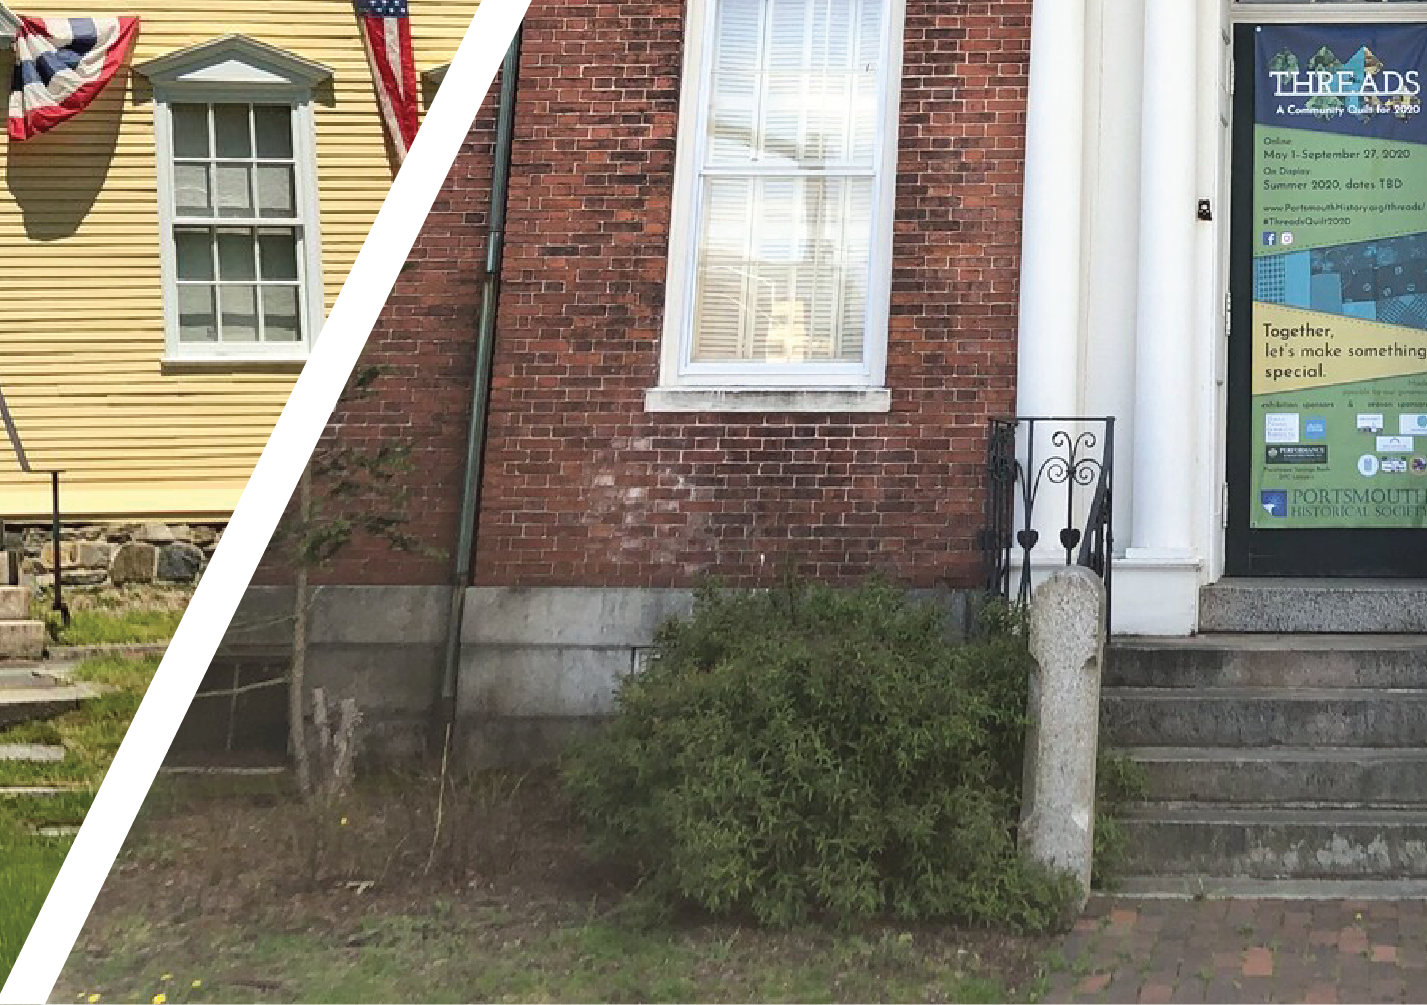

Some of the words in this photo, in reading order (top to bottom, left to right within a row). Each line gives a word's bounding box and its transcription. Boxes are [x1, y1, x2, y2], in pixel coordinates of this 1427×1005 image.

[1268, 70, 1421, 96] THREADS
[1275, 104, 1285, 114] A
[1287, 104, 1345, 117] Community
[1263, 136, 1292, 146] Online
[1263, 149, 1288, 162] May
[1382, 149, 1411, 160] 2020
[1263, 166, 1277, 176] On
[1263, 179, 1308, 191] Summer
[1311, 179, 1342, 191] 2020,
[1344, 178, 1376, 190] dates
[1379, 178, 1404, 190] TBD
[1262, 322, 1334, 340] Together,
[1265, 342, 1296, 357] let's
[1300, 342, 1342, 357] make
[1348, 342, 1427, 359] something
[1265, 363, 1327, 381] special.
[1290, 504, 1369, 517] HISTORICAL
[1374, 504, 1427, 517] SOCIETY
